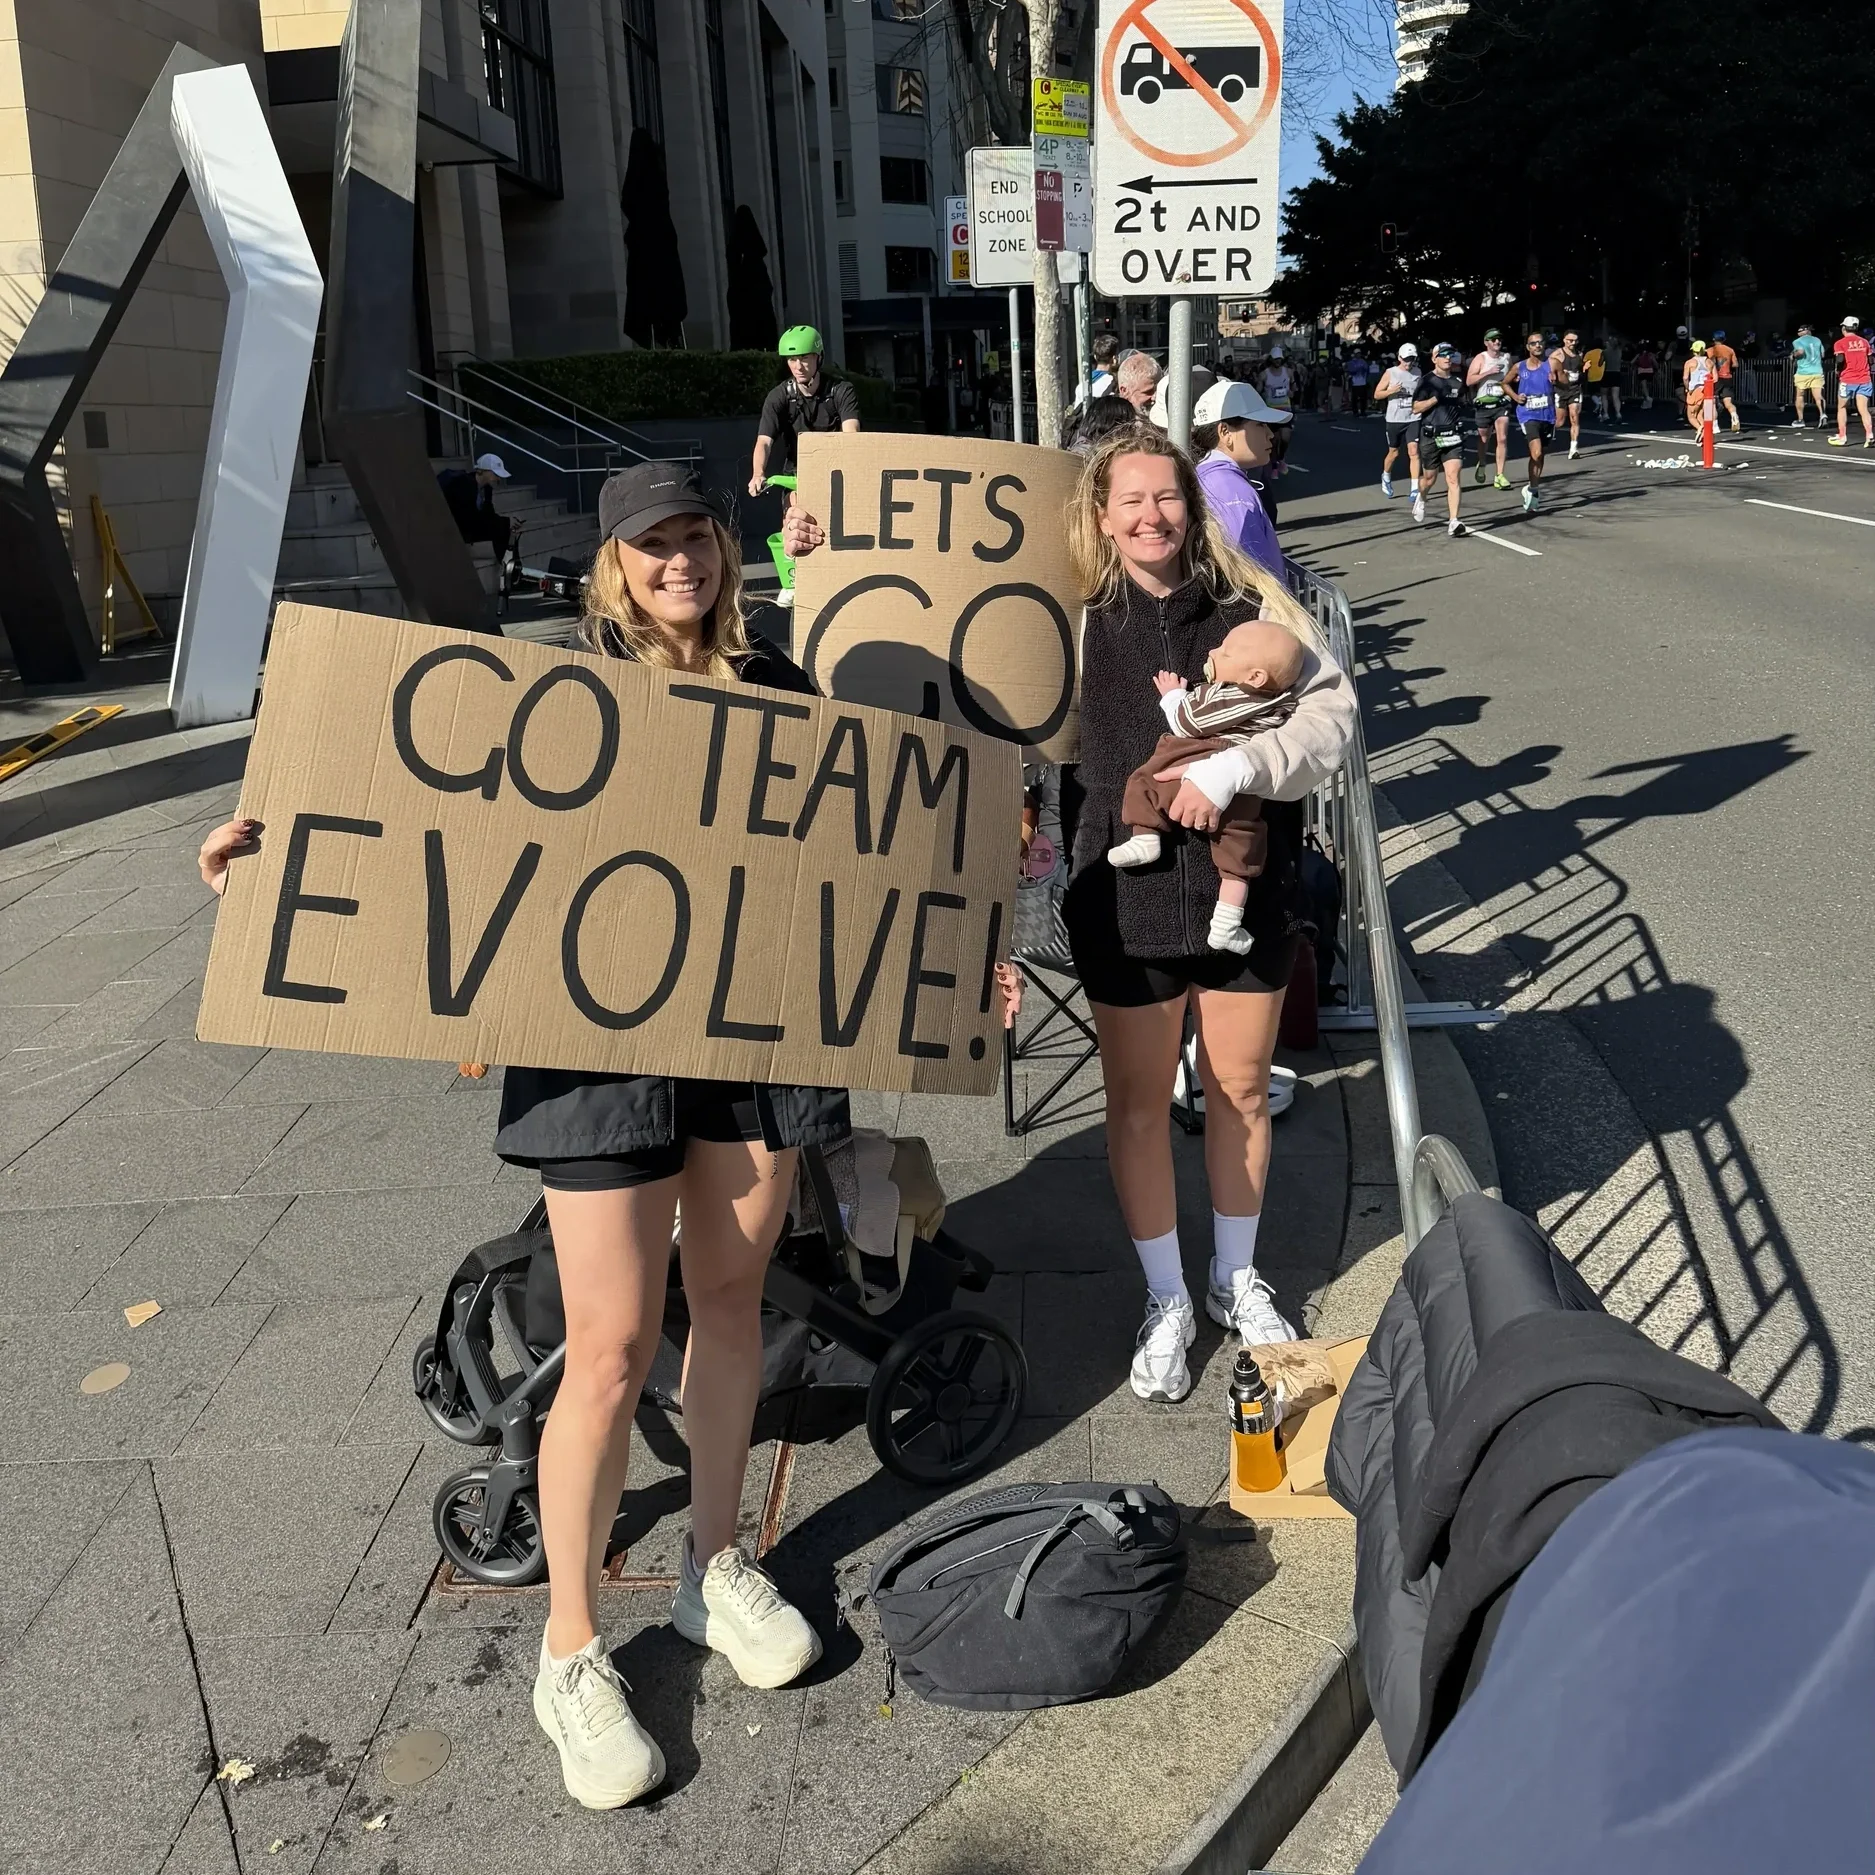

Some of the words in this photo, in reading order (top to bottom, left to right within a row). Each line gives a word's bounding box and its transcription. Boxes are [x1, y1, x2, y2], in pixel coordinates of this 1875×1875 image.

[1039, 138, 1059, 154] 4P
[991, 181, 1018, 194] END
[1043, 175, 1055, 188] NO
[1036, 190, 1063, 202] STOPPING
[979, 210, 1032, 223] SCHOOL
[1114, 197, 1167, 233] 2t
[1187, 206, 1261, 232] AND
[989, 238, 1027, 252] ZONE
[1121, 248, 1252, 284] OVER
[830, 467, 1028, 563] LET'S
[802, 574, 1075, 746] GO
[392, 644, 620, 810] GO
[668, 684, 969, 874] TEAM
[262, 812, 1003, 1061] EVOLVE!
